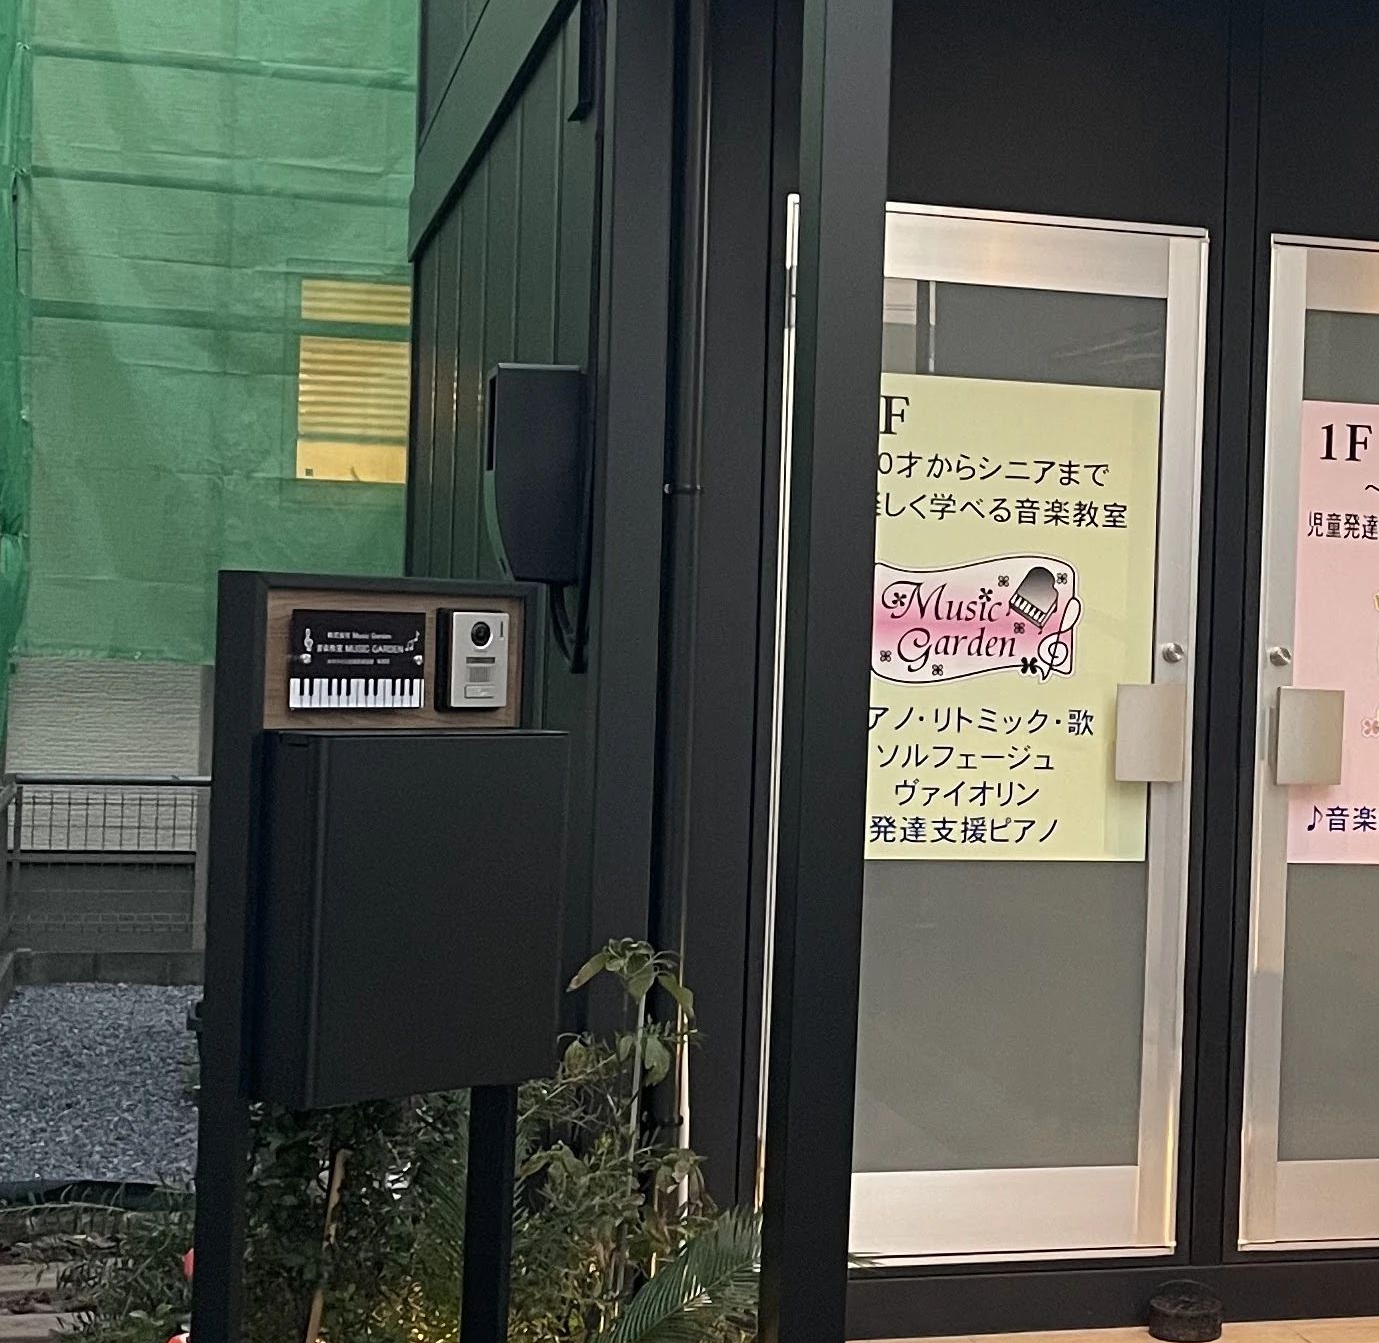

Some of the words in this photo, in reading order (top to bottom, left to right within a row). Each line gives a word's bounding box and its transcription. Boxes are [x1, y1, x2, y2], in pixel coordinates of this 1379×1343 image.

[1319, 423, 1373, 463] 1F
[875, 488, 1128, 529] しく学べる音楽教室
[881, 579, 1004, 623] Music
[897, 627, 1017, 673] Garden
[877, 743, 1055, 771] ソルフェージュ
[894, 777, 1040, 807] ヴァイオリン
[869, 815, 1058, 844] 発達支援ピアノ
